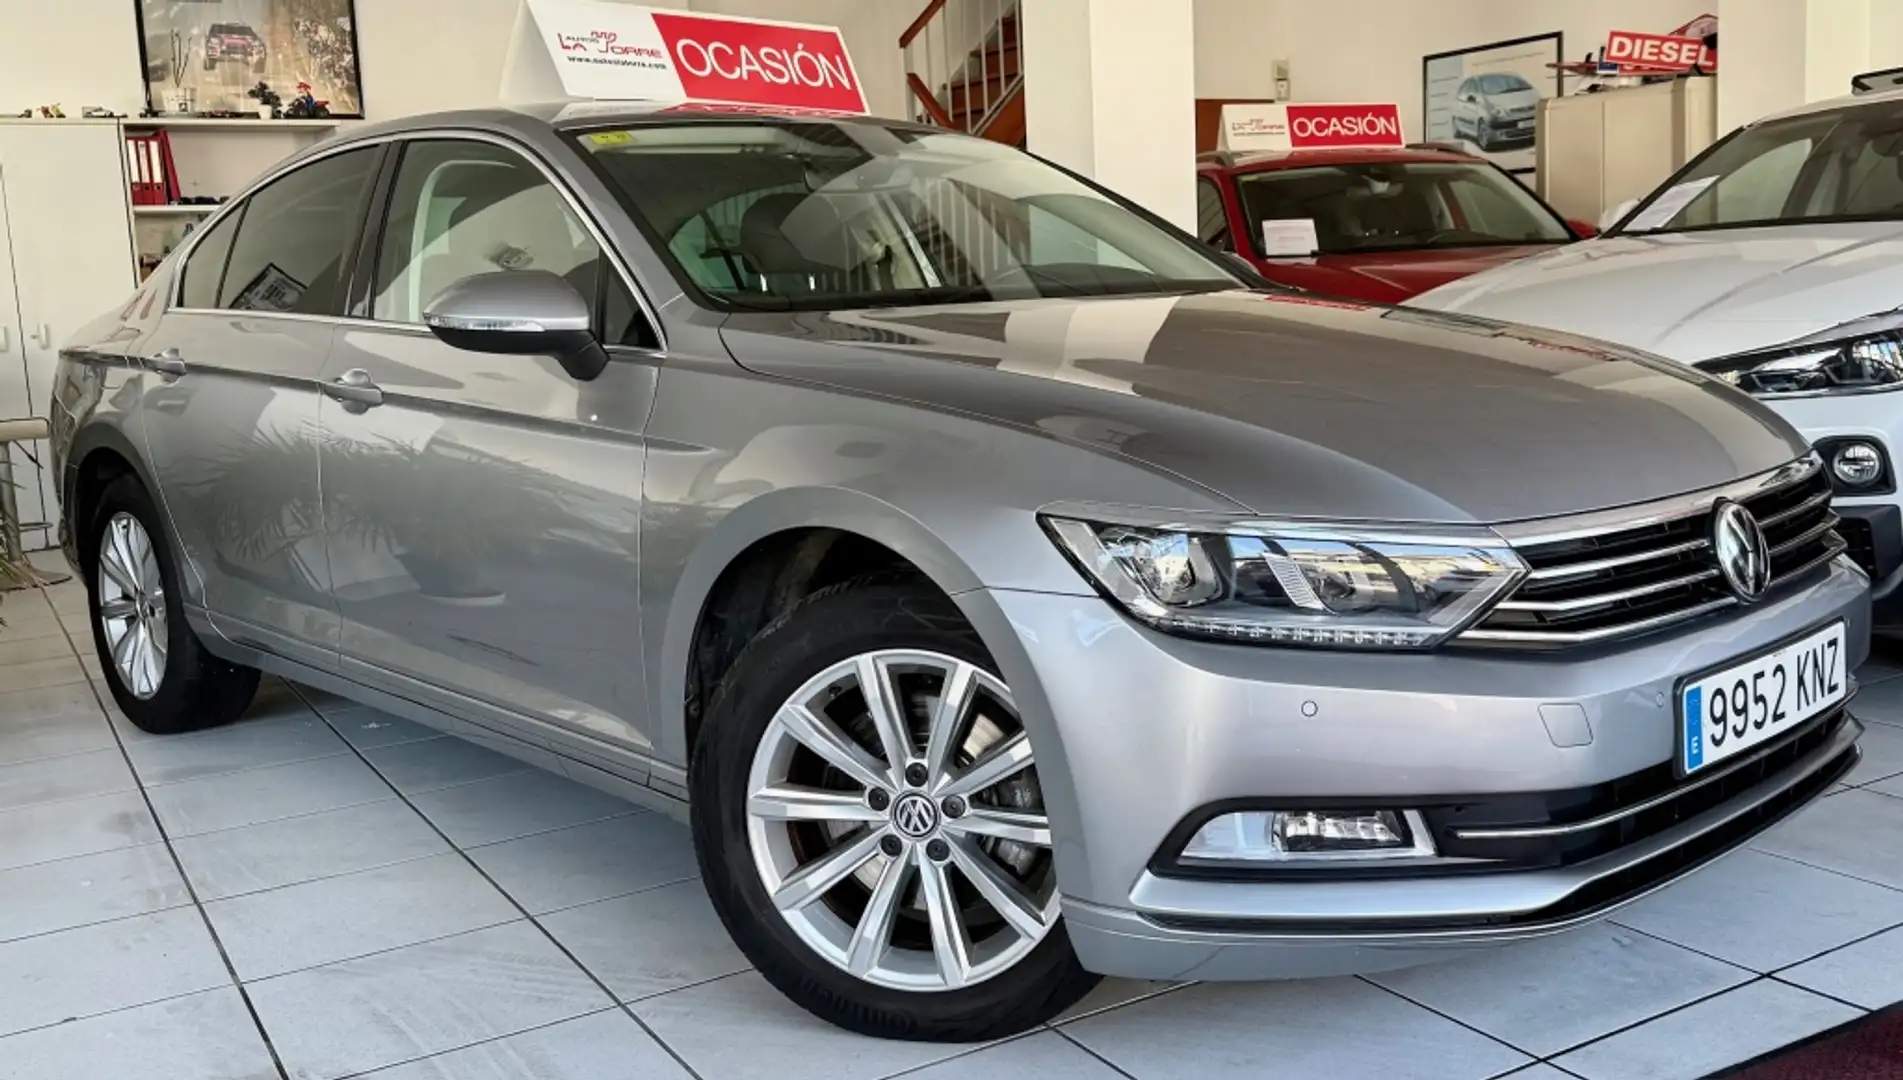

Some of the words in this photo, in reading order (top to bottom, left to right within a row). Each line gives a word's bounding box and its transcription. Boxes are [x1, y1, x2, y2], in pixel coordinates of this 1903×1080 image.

[676, 38, 852, 90] OCASIÓN
[1609, 36, 1715, 67] DIESEL
[1292, 111, 1397, 138] OCASIÓN
[1709, 662, 1787, 748] 9952
[1796, 637, 1840, 712] KNZ
[1690, 735, 1700, 755] E
